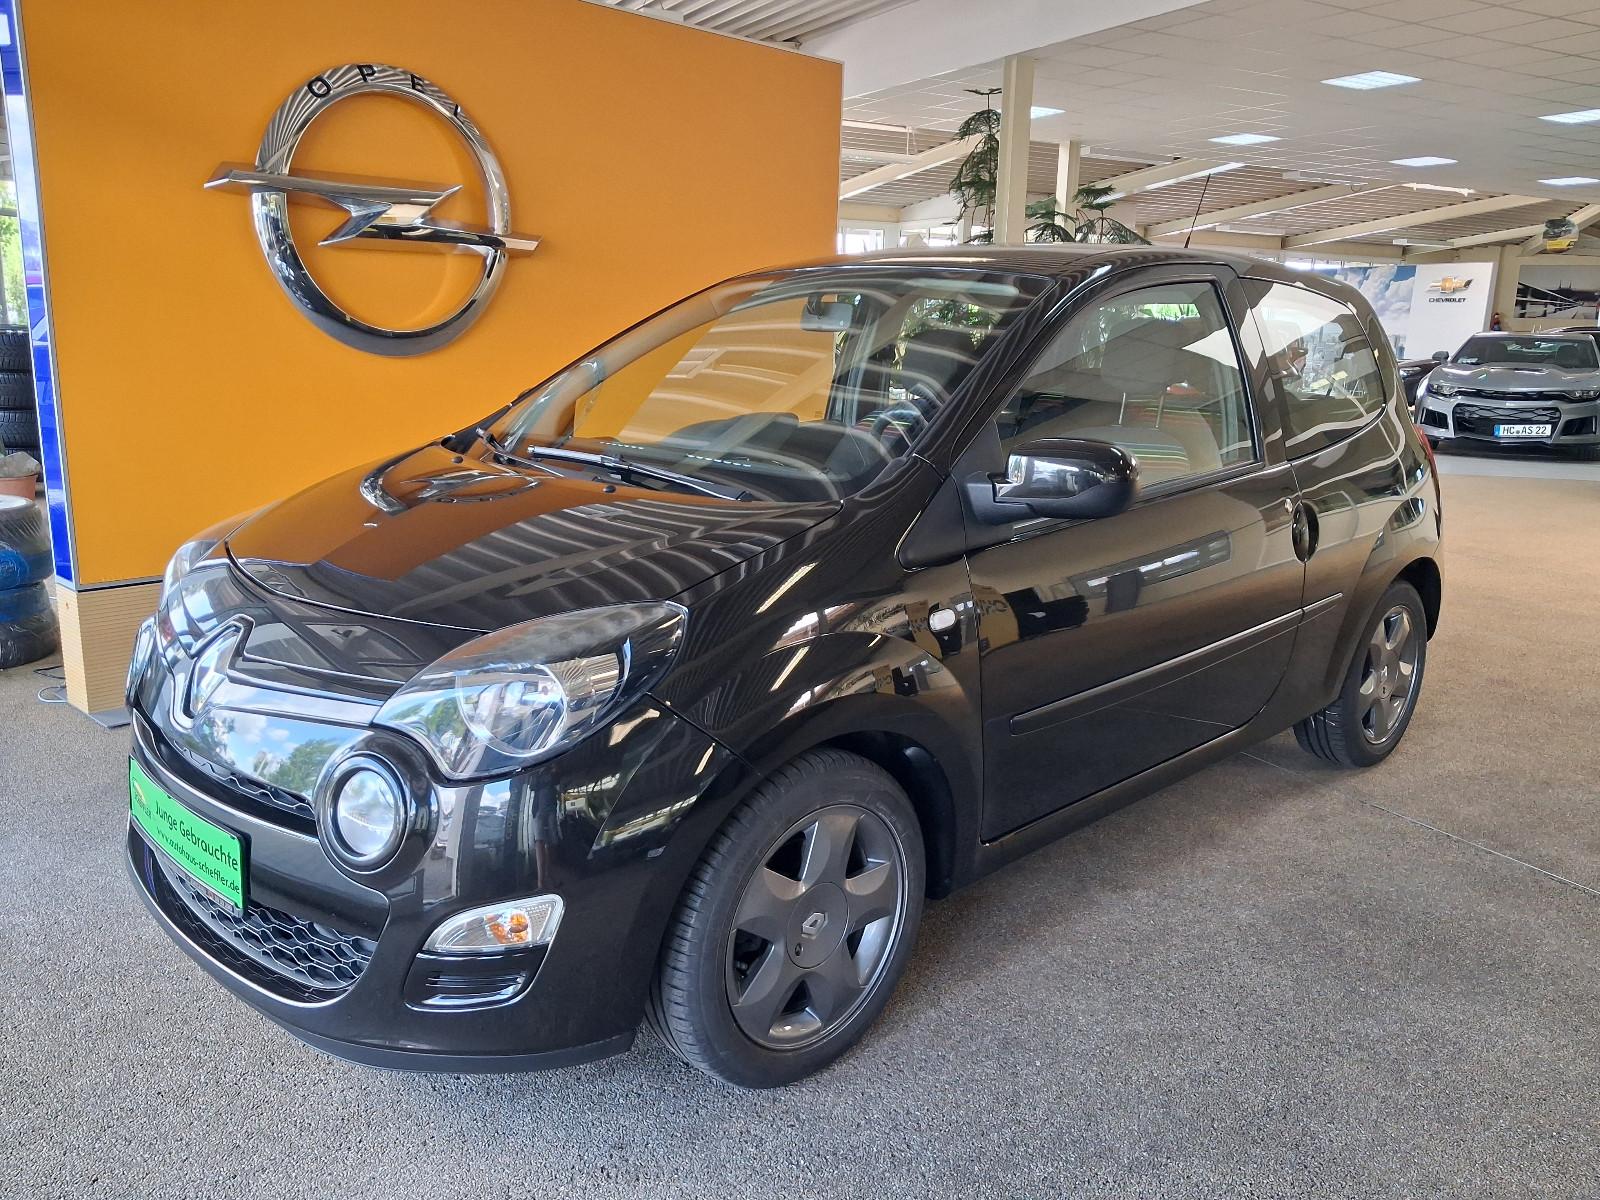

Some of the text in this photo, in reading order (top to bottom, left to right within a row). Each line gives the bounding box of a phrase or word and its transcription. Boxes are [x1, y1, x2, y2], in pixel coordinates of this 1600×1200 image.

[307, 64, 464, 124] OPEL
[1535, 426, 1547, 435] 22
[155, 799, 178, 831] Junge
[179, 821, 239, 871] Gebrauchte
[156, 826, 241, 894] www.autohaus-scheffler.de
